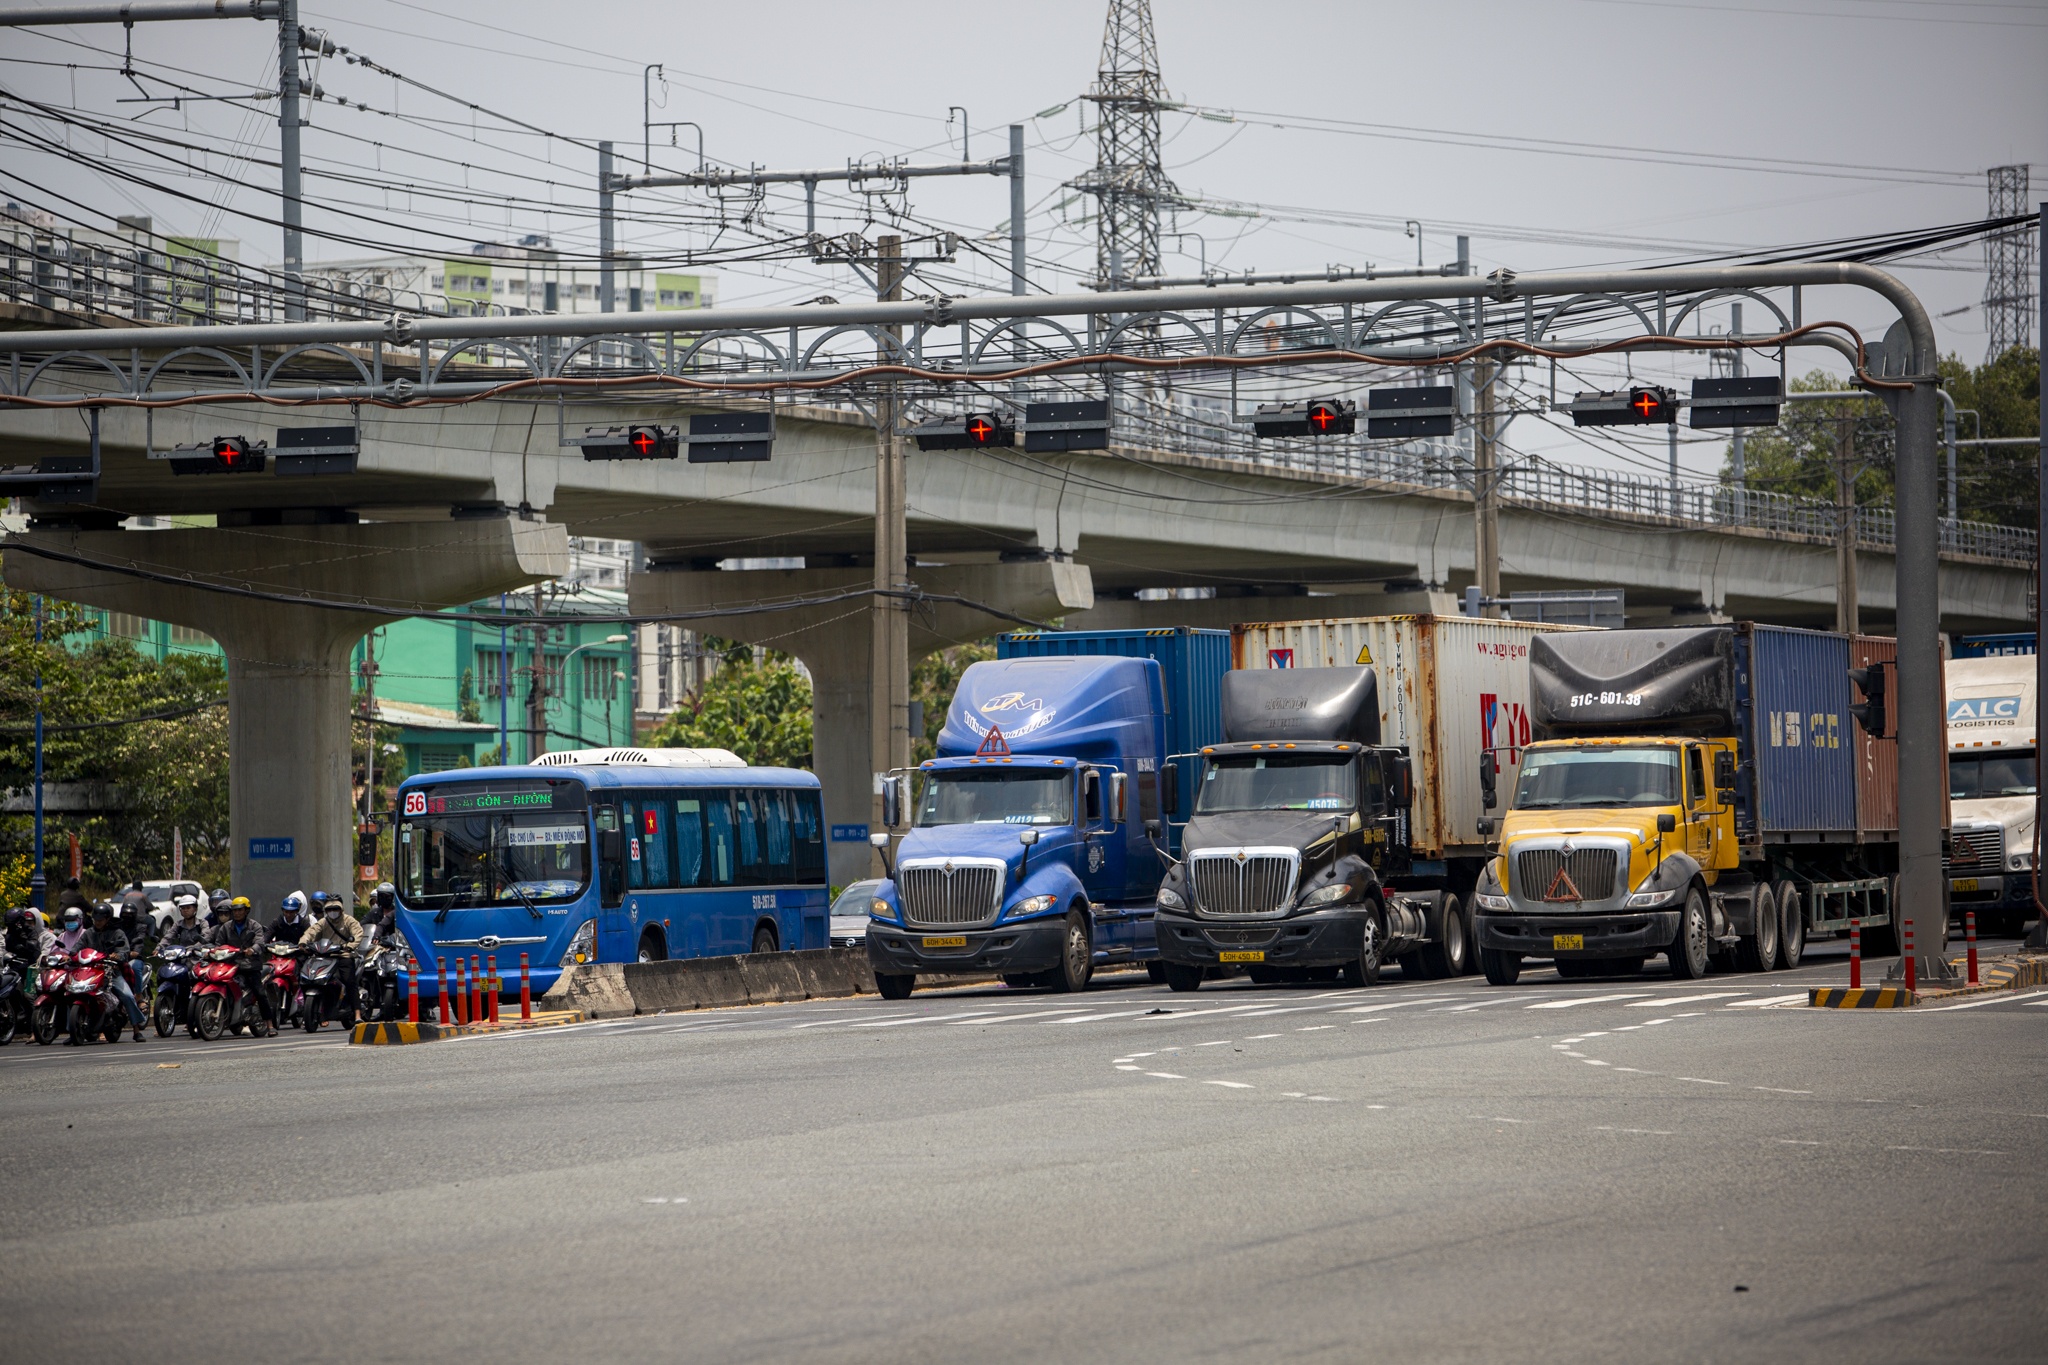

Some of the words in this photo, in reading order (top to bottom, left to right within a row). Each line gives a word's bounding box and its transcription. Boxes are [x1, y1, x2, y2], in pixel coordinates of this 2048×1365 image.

[1950, 700, 2016, 719] ALC
[1947, 719, 2015, 729] LOGISTICS
[406, 794, 425, 813] 56
[476, 793, 501, 806] GÒN
[1309, 800, 1338, 808] 45075
[631, 840, 640, 859] 56
